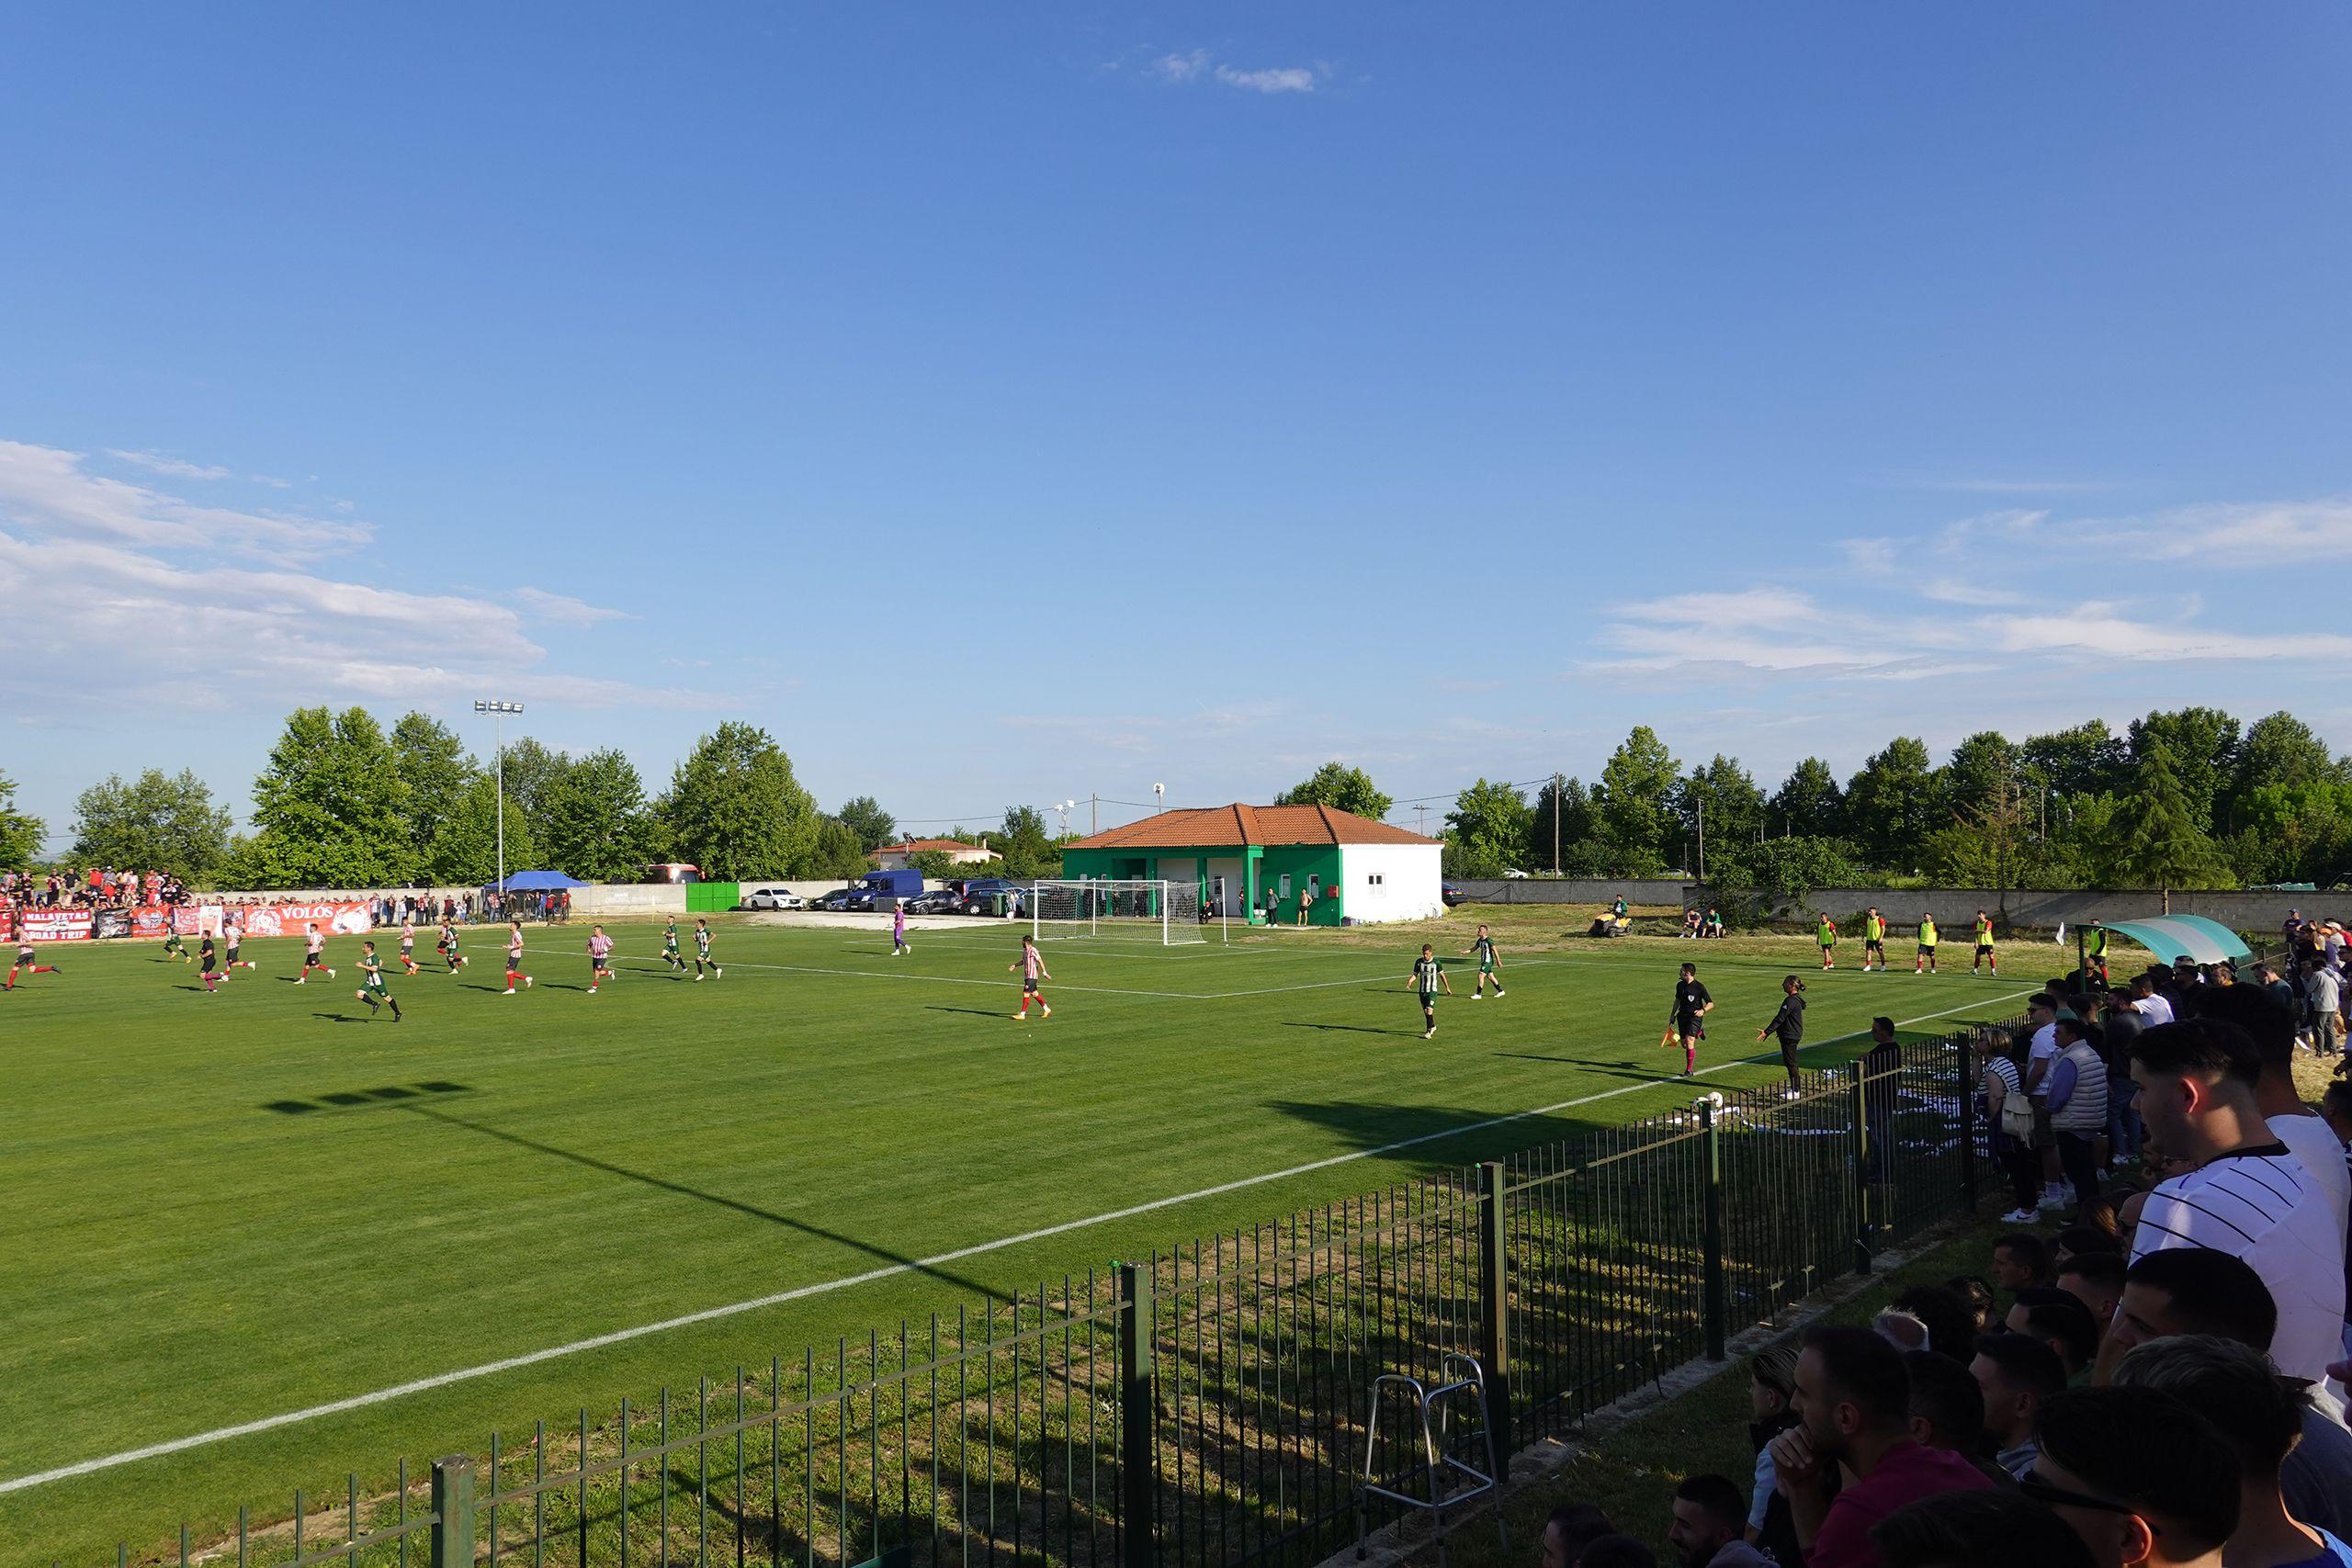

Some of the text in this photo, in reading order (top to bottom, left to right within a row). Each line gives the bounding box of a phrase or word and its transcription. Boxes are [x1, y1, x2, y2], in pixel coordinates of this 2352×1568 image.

[26, 912, 89, 920] MALAVETAS
[29, 931, 87, 940] ROAD TRIP
